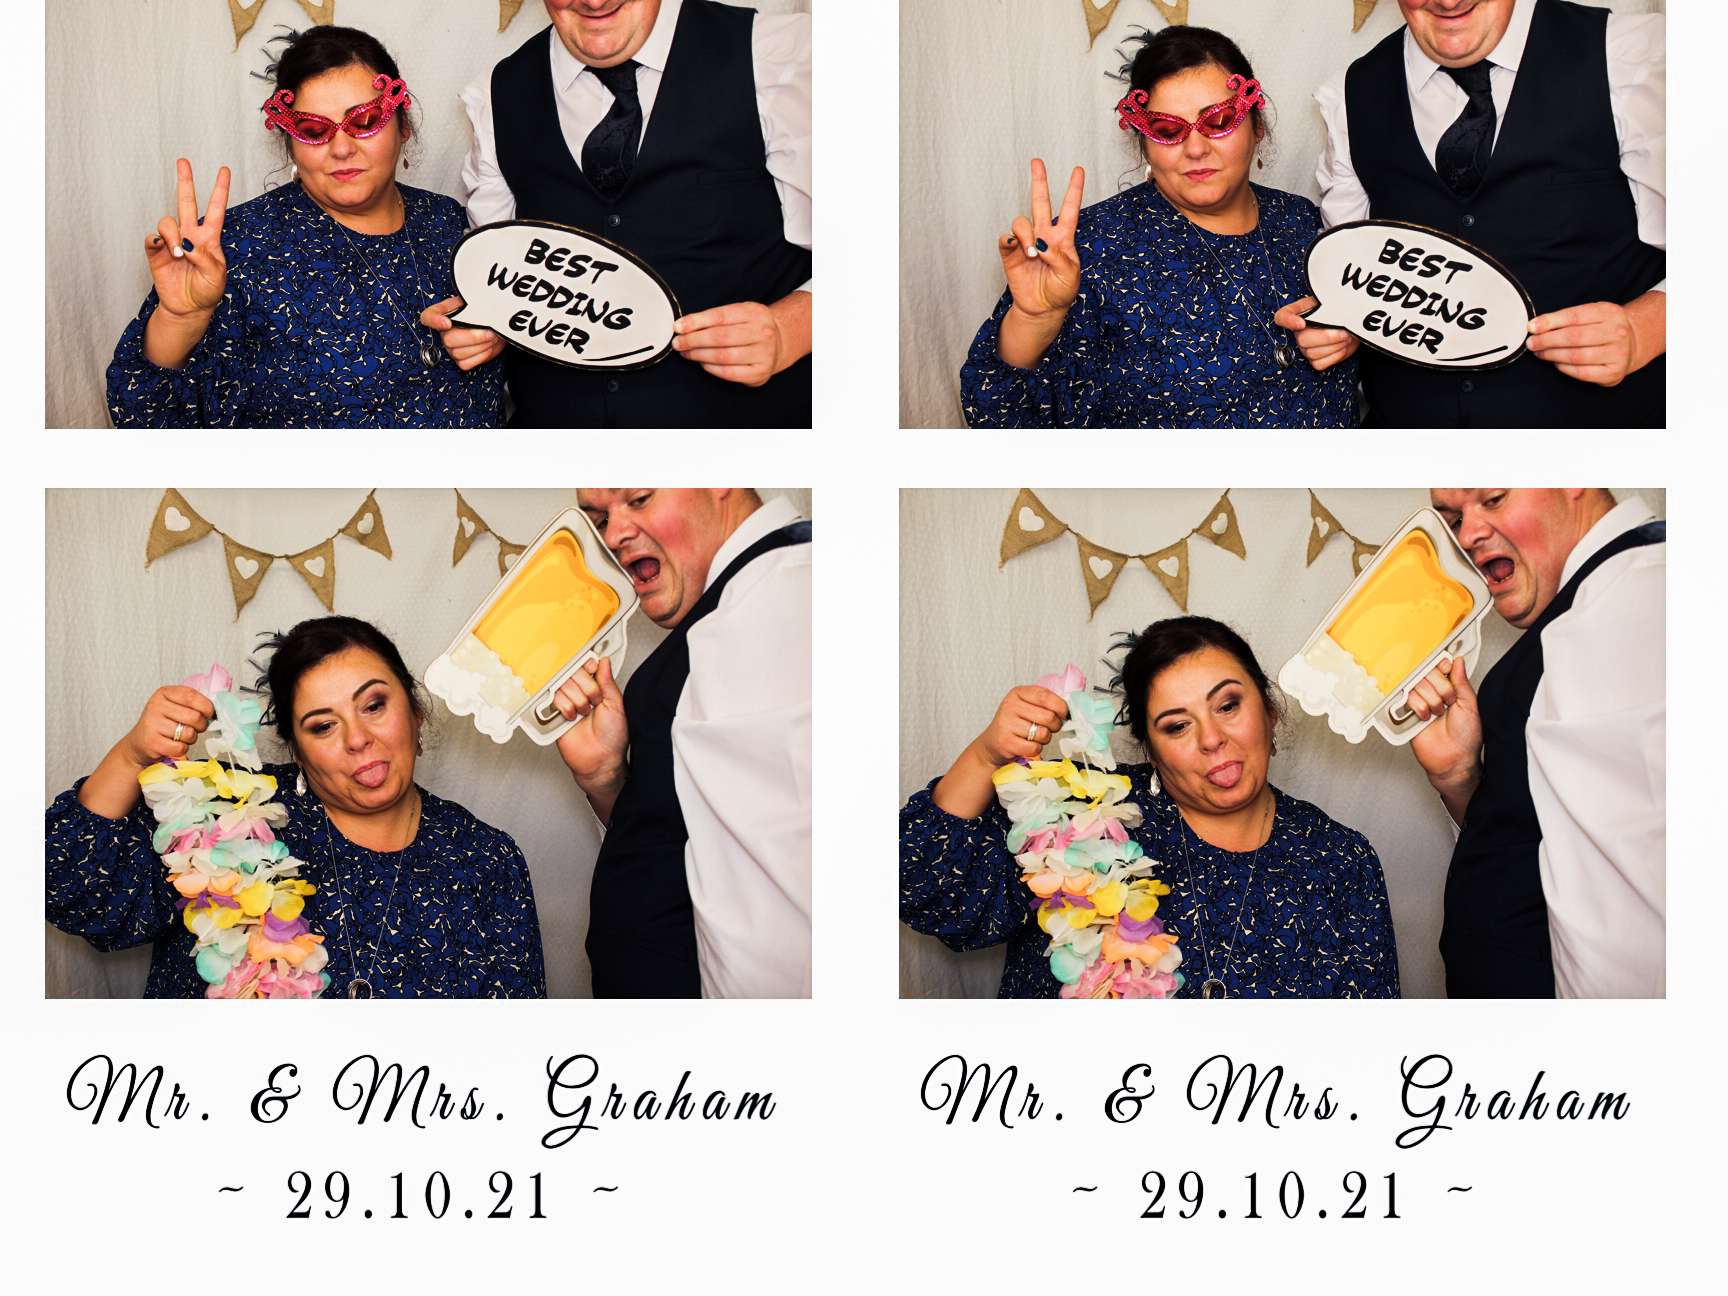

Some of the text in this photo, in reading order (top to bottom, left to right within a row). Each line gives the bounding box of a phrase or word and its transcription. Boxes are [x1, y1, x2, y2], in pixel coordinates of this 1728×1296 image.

[524, 238, 619, 285] BEST
[1378, 238, 1473, 285] BEST
[487, 263, 633, 330] WEDDING
[1341, 263, 1487, 330] WEDDING
[508, 310, 590, 354] EVER
[1362, 310, 1444, 354] EVER
